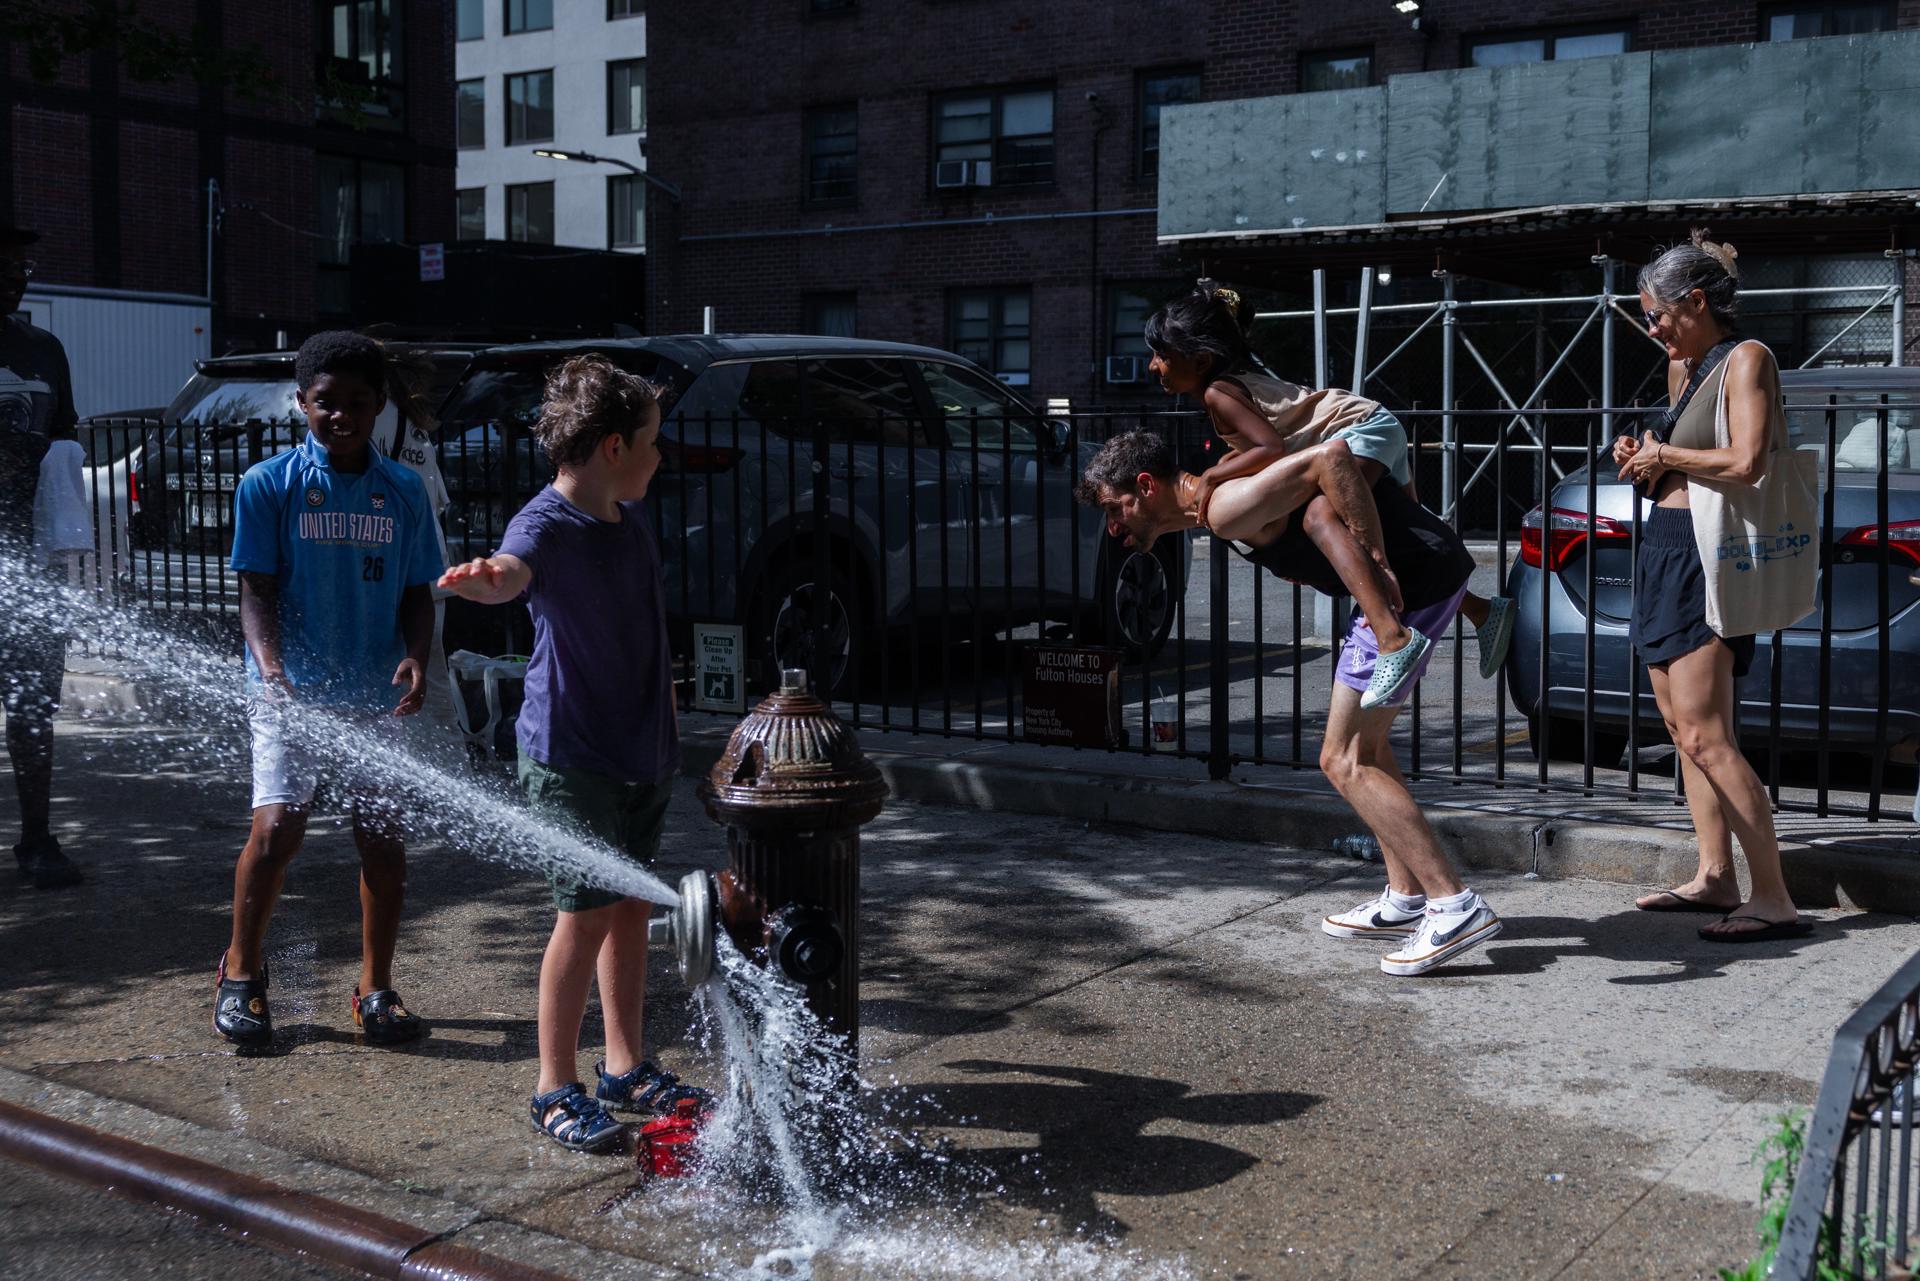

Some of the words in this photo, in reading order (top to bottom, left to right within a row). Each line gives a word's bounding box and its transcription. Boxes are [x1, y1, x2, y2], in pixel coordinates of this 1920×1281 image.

[299, 512, 346, 539] UNITED
[350, 513, 393, 543] STATES
[363, 556, 384, 582] 26
[707, 637, 730, 646] Please
[724, 647, 733, 655] Up
[1038, 651, 1085, 668] WELCOME
[1087, 654, 1100, 669] TO
[706, 664, 720, 672] Your
[721, 665, 732, 673] Pet
[1035, 666, 1065, 682] Fulton
[1067, 669, 1104, 684] Houses
[1025, 705, 1048, 717] Property
[1049, 708, 1056, 717] of
[1025, 716, 1038, 724] New
[1038, 717, 1050, 725] York
[1050, 717, 1062, 728] City
[1025, 724, 1047, 735] Housing
[1047, 727, 1073, 738] Authority
